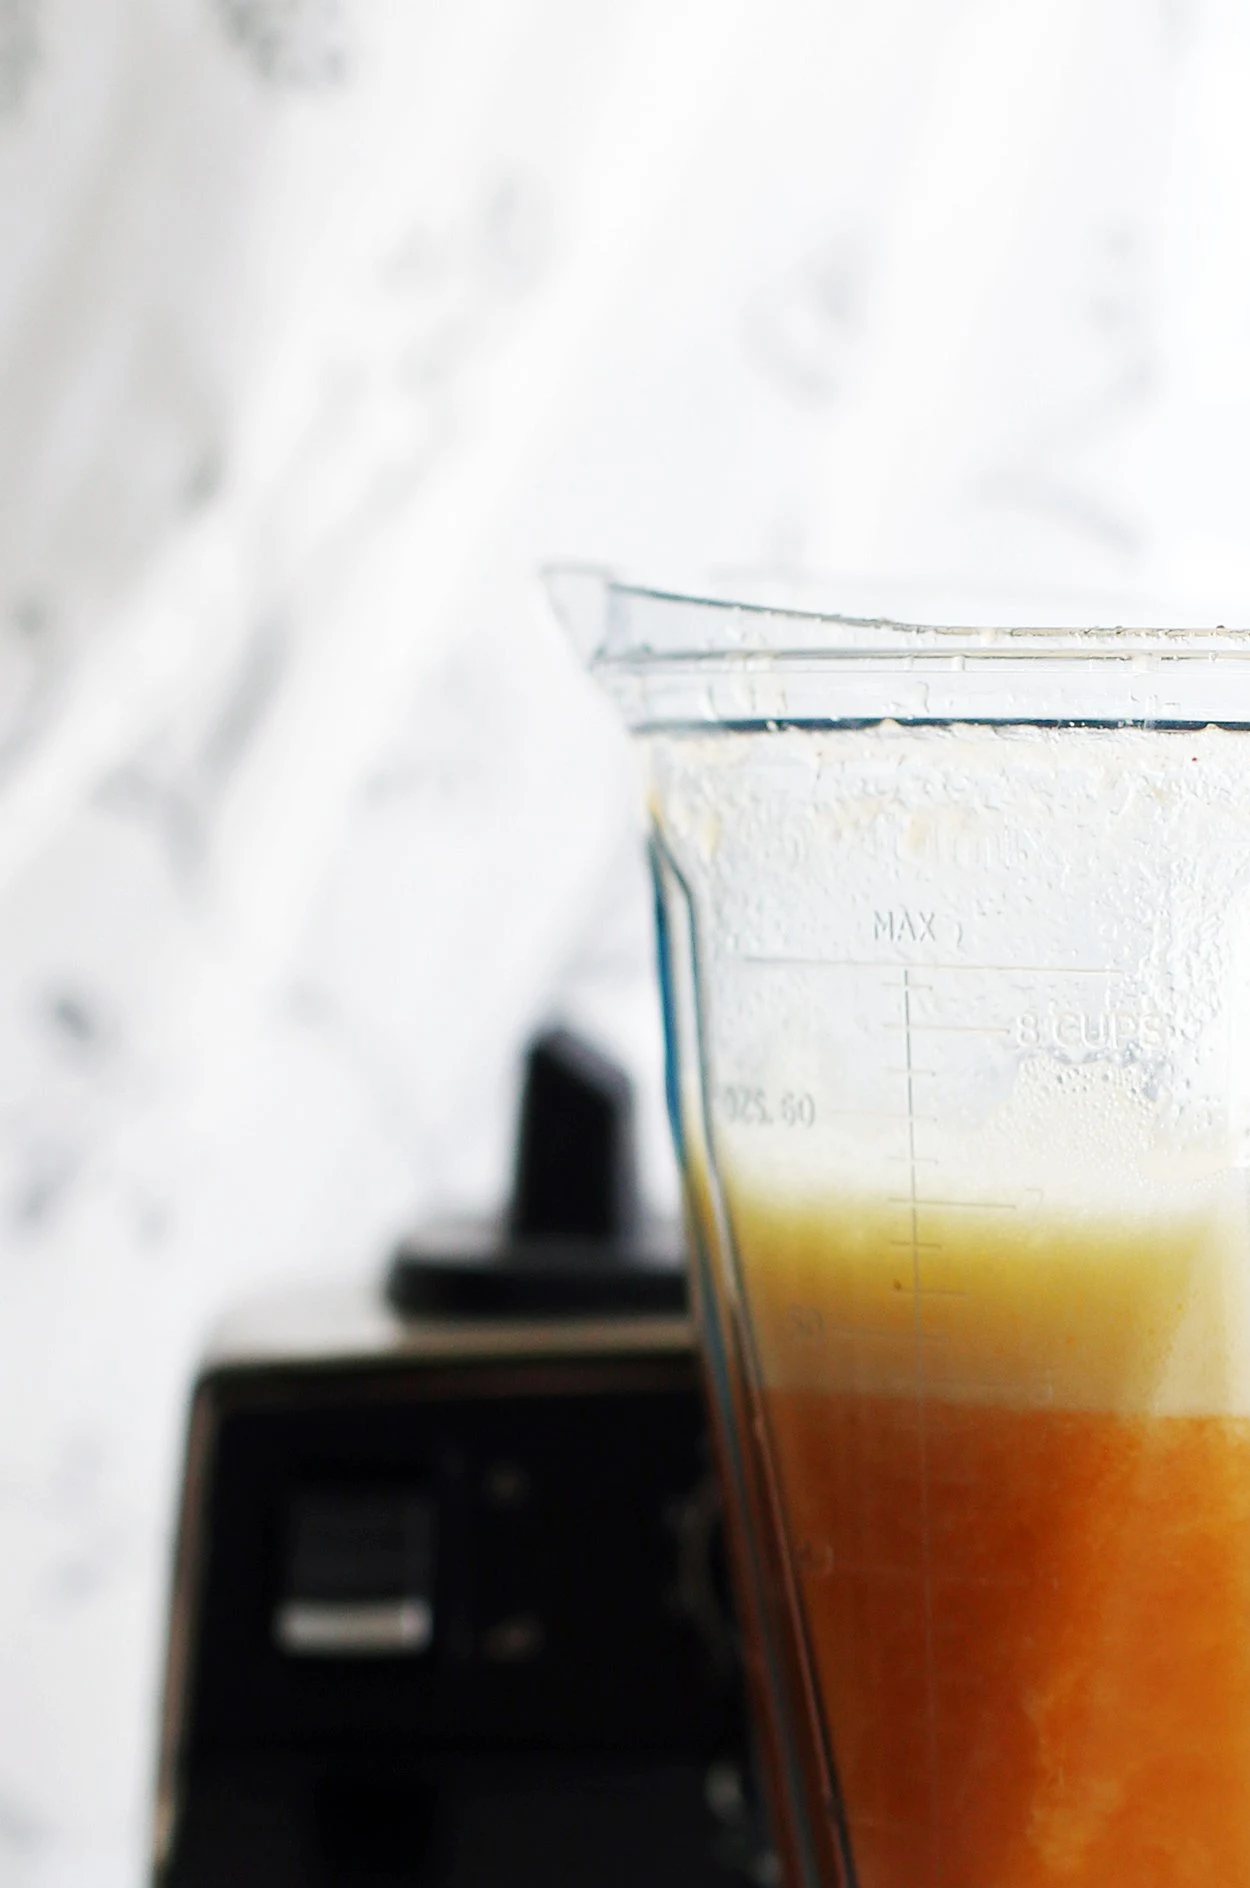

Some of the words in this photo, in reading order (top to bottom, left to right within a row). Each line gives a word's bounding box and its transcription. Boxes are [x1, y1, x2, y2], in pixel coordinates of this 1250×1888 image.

[872, 907, 937, 942] MAX
[1015, 1013, 1040, 1048] 8
[1051, 1013, 1166, 1049] CUPS
